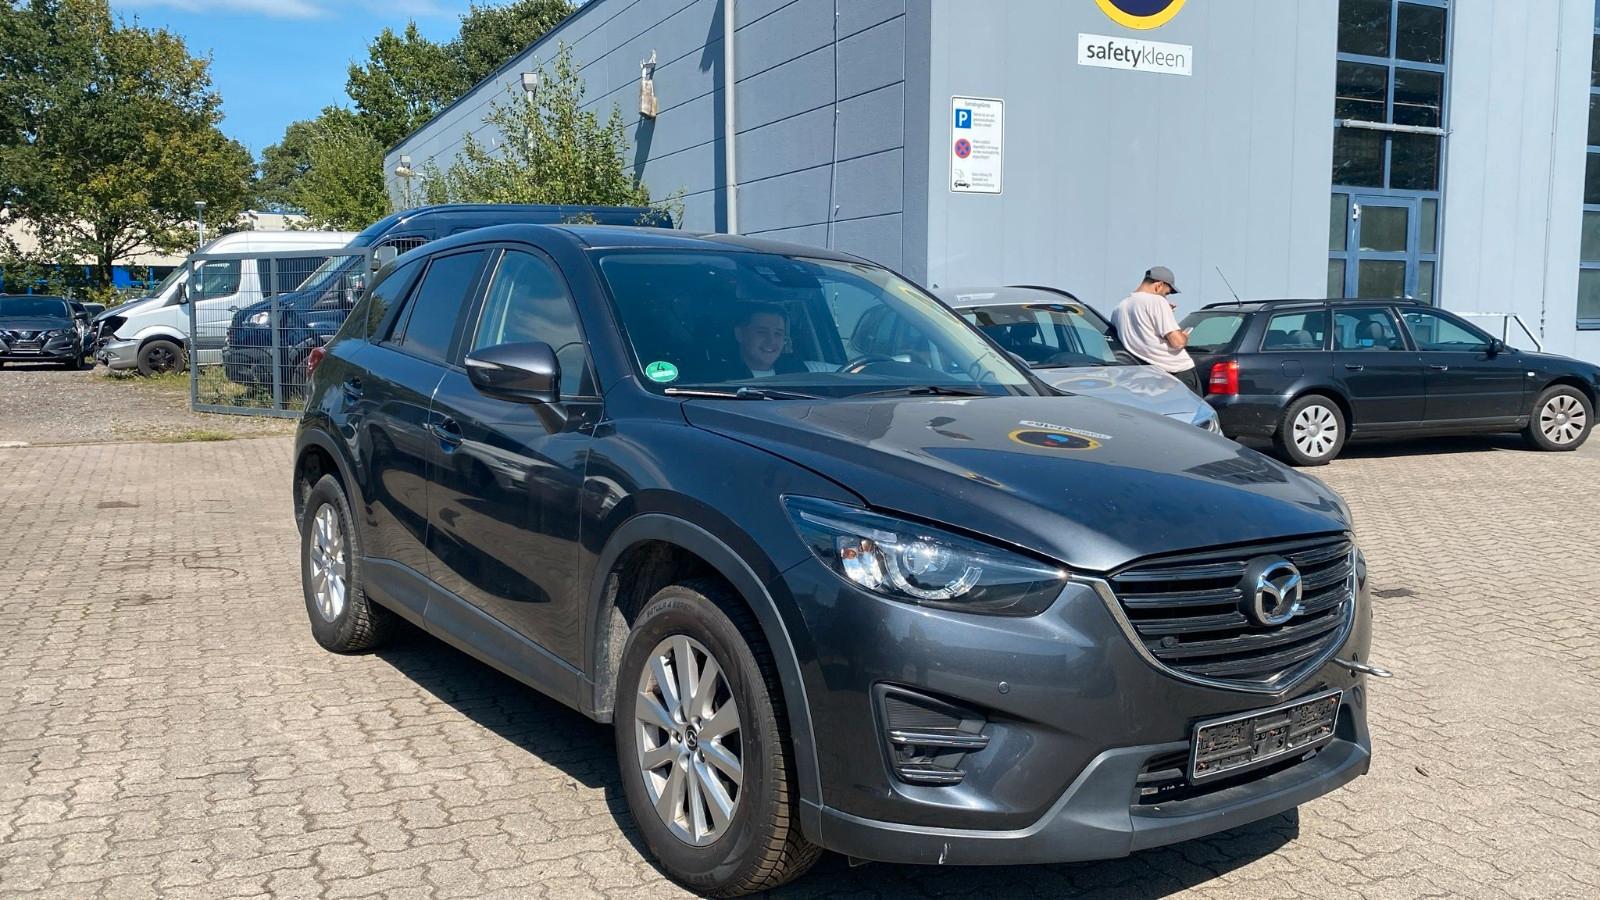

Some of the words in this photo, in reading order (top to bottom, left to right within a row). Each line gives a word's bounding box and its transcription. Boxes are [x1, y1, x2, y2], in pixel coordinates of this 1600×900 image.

[1087, 41, 1185, 68] safetykleen
[959, 111, 968, 126] P
[657, 362, 665, 371] 4
